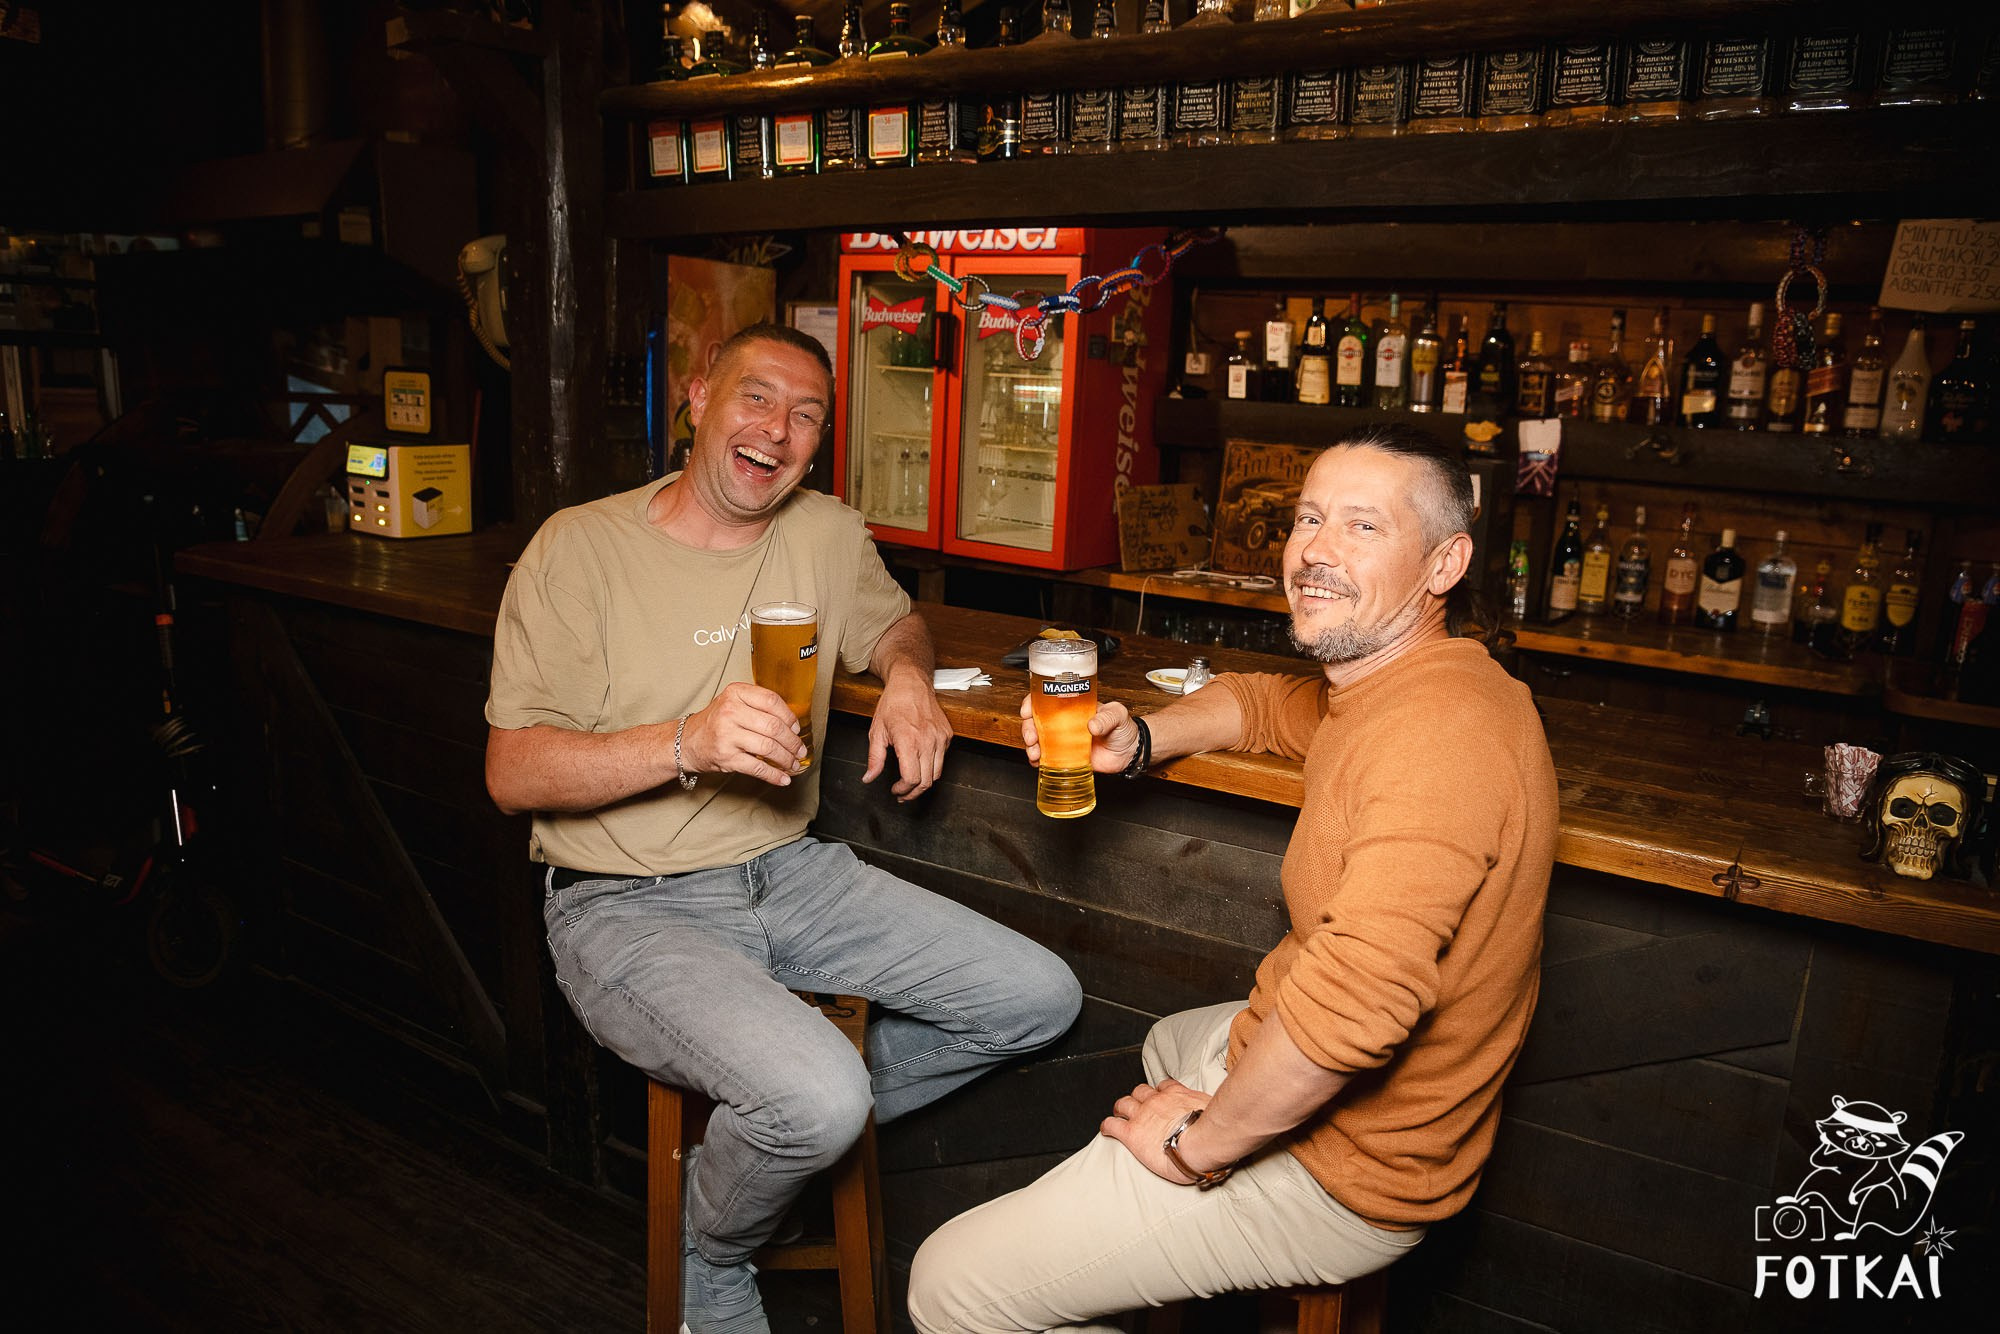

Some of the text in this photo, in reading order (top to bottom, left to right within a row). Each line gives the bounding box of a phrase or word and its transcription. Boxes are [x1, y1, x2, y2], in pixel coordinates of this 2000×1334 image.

[1804, 37, 1848, 47] Tennessee
[1715, 43, 1758, 53] Tennessee
[1636, 54, 1676, 63] Tennessee
[1803, 49, 1845, 59] WHISKEY
[1563, 55, 1602, 64] Tennessee
[1714, 55, 1756, 65] WHISKEY
[1563, 66, 1600, 76] WHISKEY
[1636, 65, 1674, 74] WHISKEY
[1488, 81, 1530, 91] WHISKEY
[1357, 92, 1395, 101] WHISKEY
[1901, 225, 1969, 246] MINTTU
[1889, 276, 1963, 297] ABSINTHE
[864, 305, 926, 323] Budweiser
[1044, 680, 1090, 693] MAGNERS
